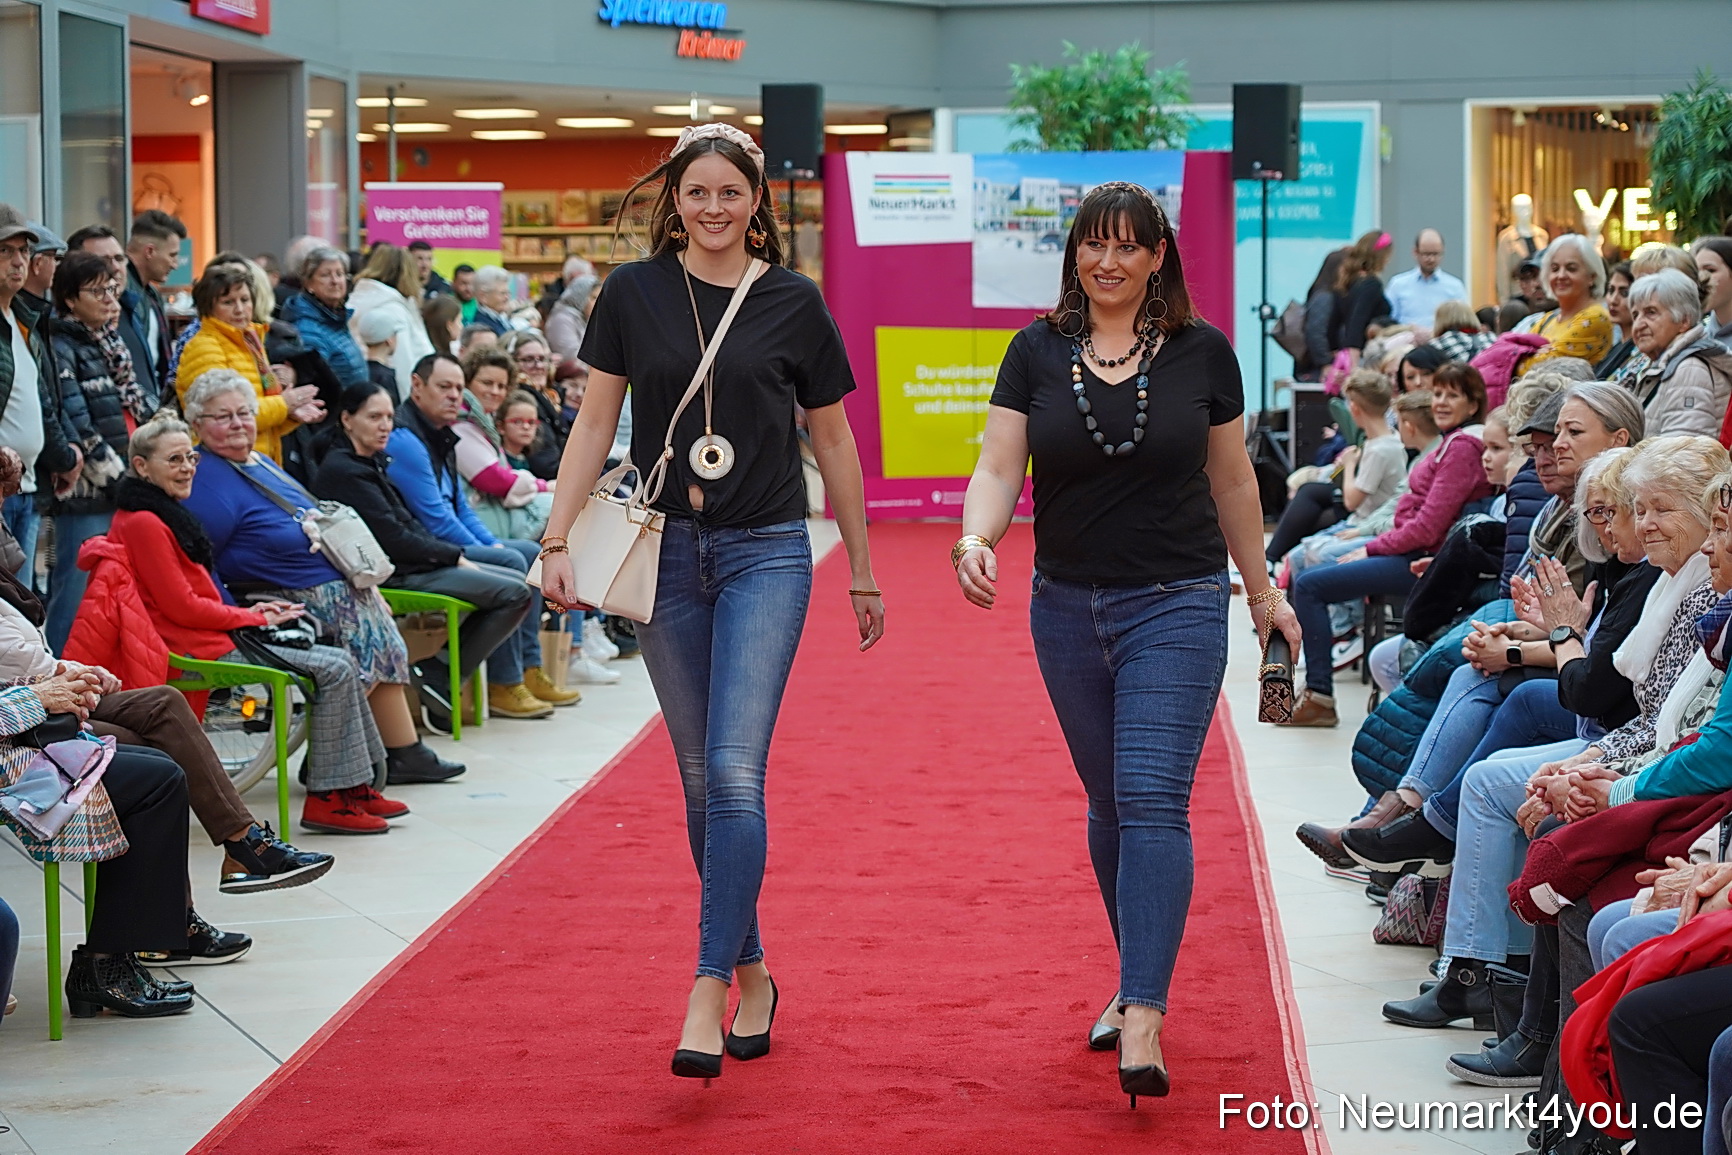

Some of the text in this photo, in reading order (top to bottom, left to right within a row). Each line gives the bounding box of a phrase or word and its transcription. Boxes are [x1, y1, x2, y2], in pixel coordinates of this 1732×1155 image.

[373, 205, 490, 222] Verschenken Sie
[1573, 187, 1678, 231] VE
[402, 222, 490, 239] Gutscheine!
[915, 364, 935, 380] Du
[903, 381, 953, 397] Schuhe
[914, 398, 942, 414] und
